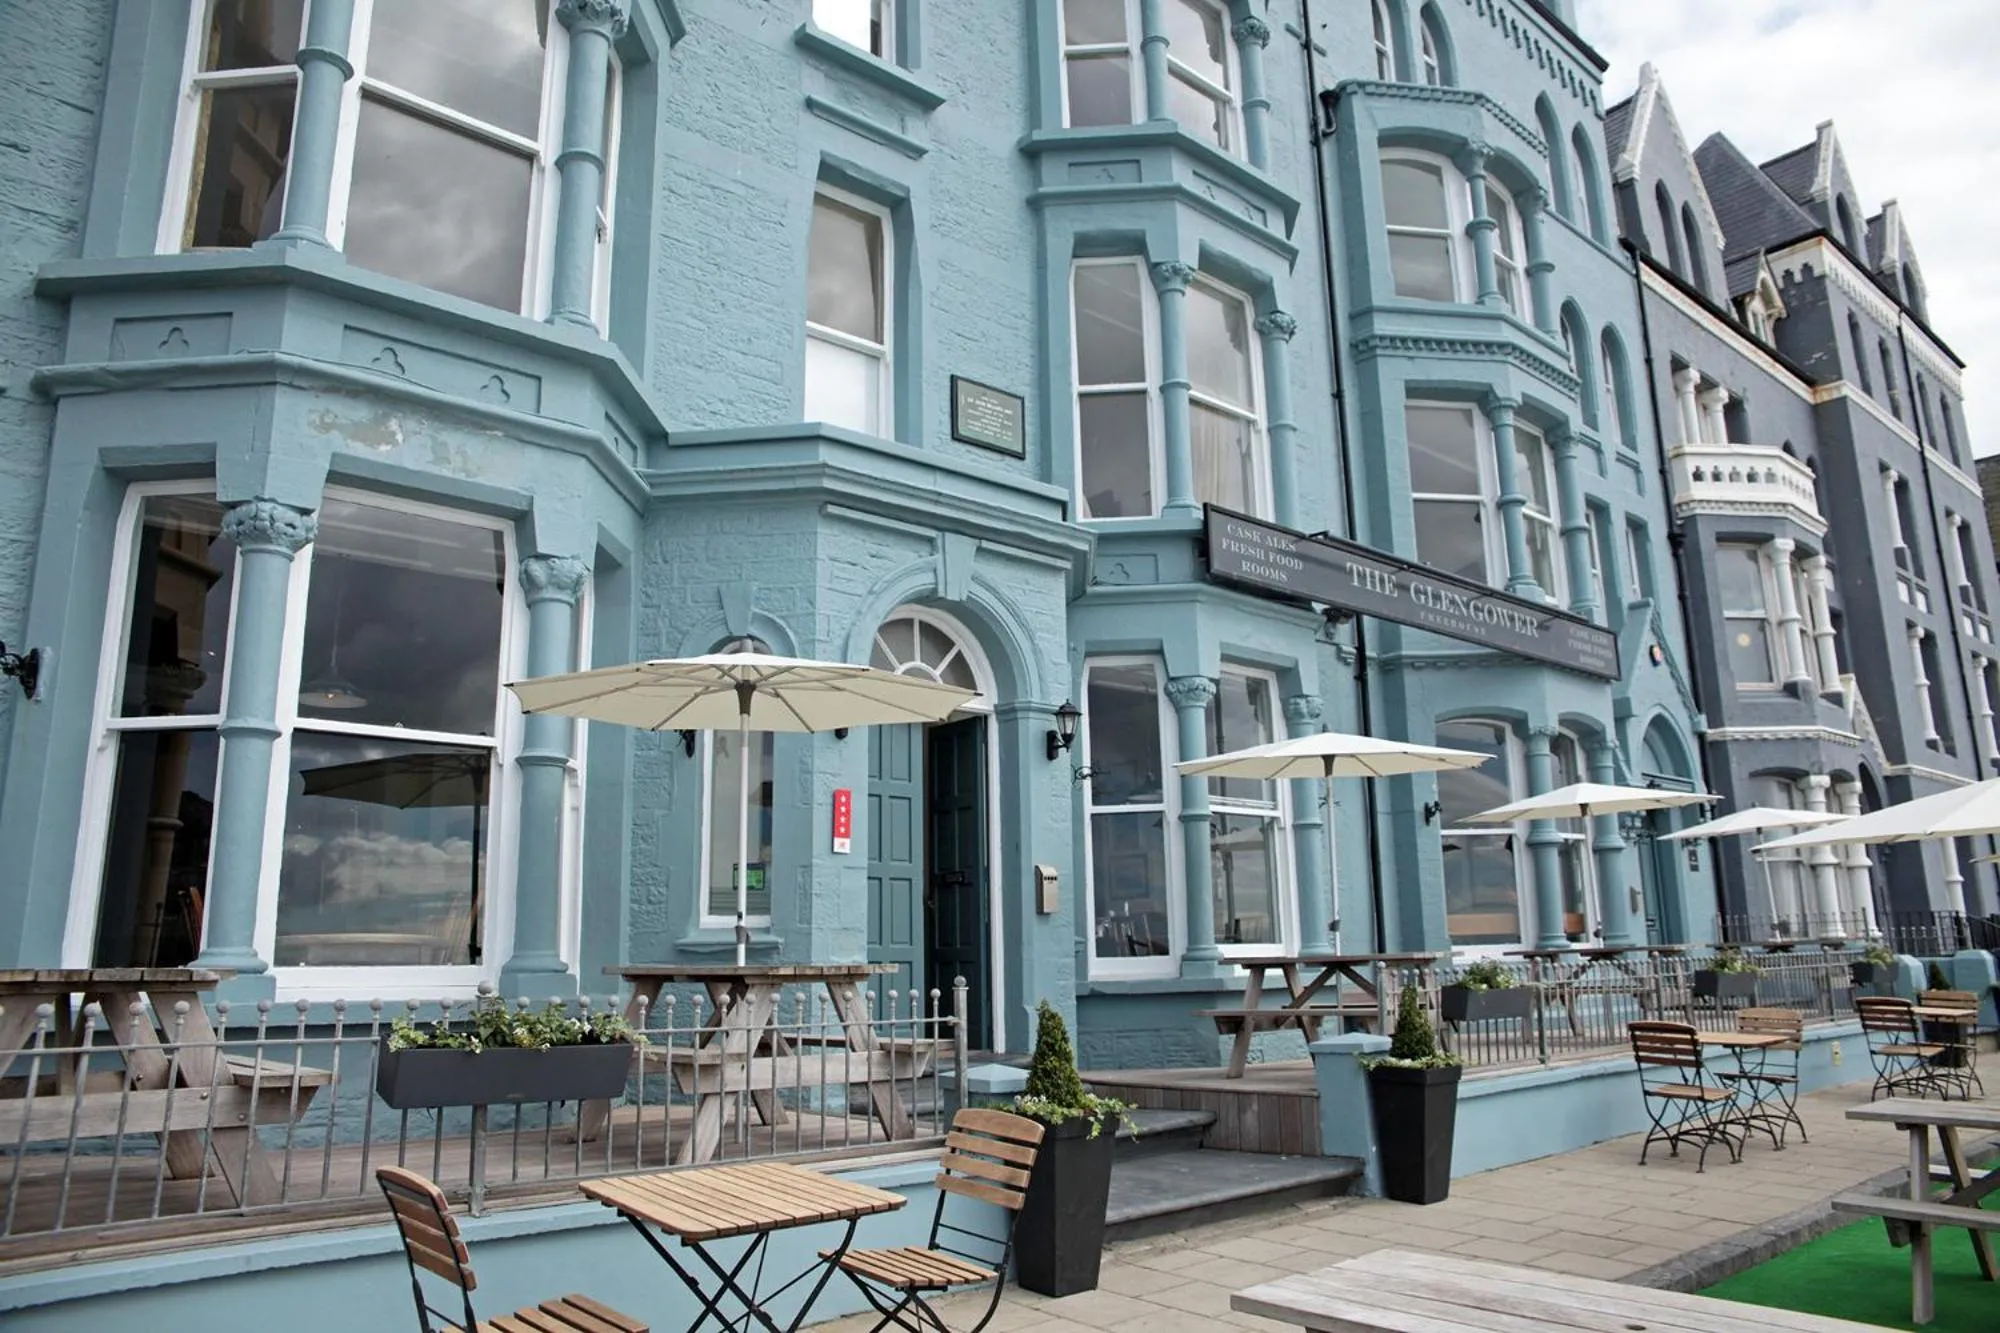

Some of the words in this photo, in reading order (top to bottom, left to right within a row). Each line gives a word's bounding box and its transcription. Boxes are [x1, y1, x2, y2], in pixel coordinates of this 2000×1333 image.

[1227, 523, 1261, 543] CASK
[1265, 535, 1297, 552] ALES
[1222, 537, 1265, 560] FRESH
[1269, 551, 1303, 571] FOOD
[1241, 560, 1288, 583] ROOMS
[1346, 562, 1398, 598] THE
[1410, 581, 1539, 638] GLENGOWER
